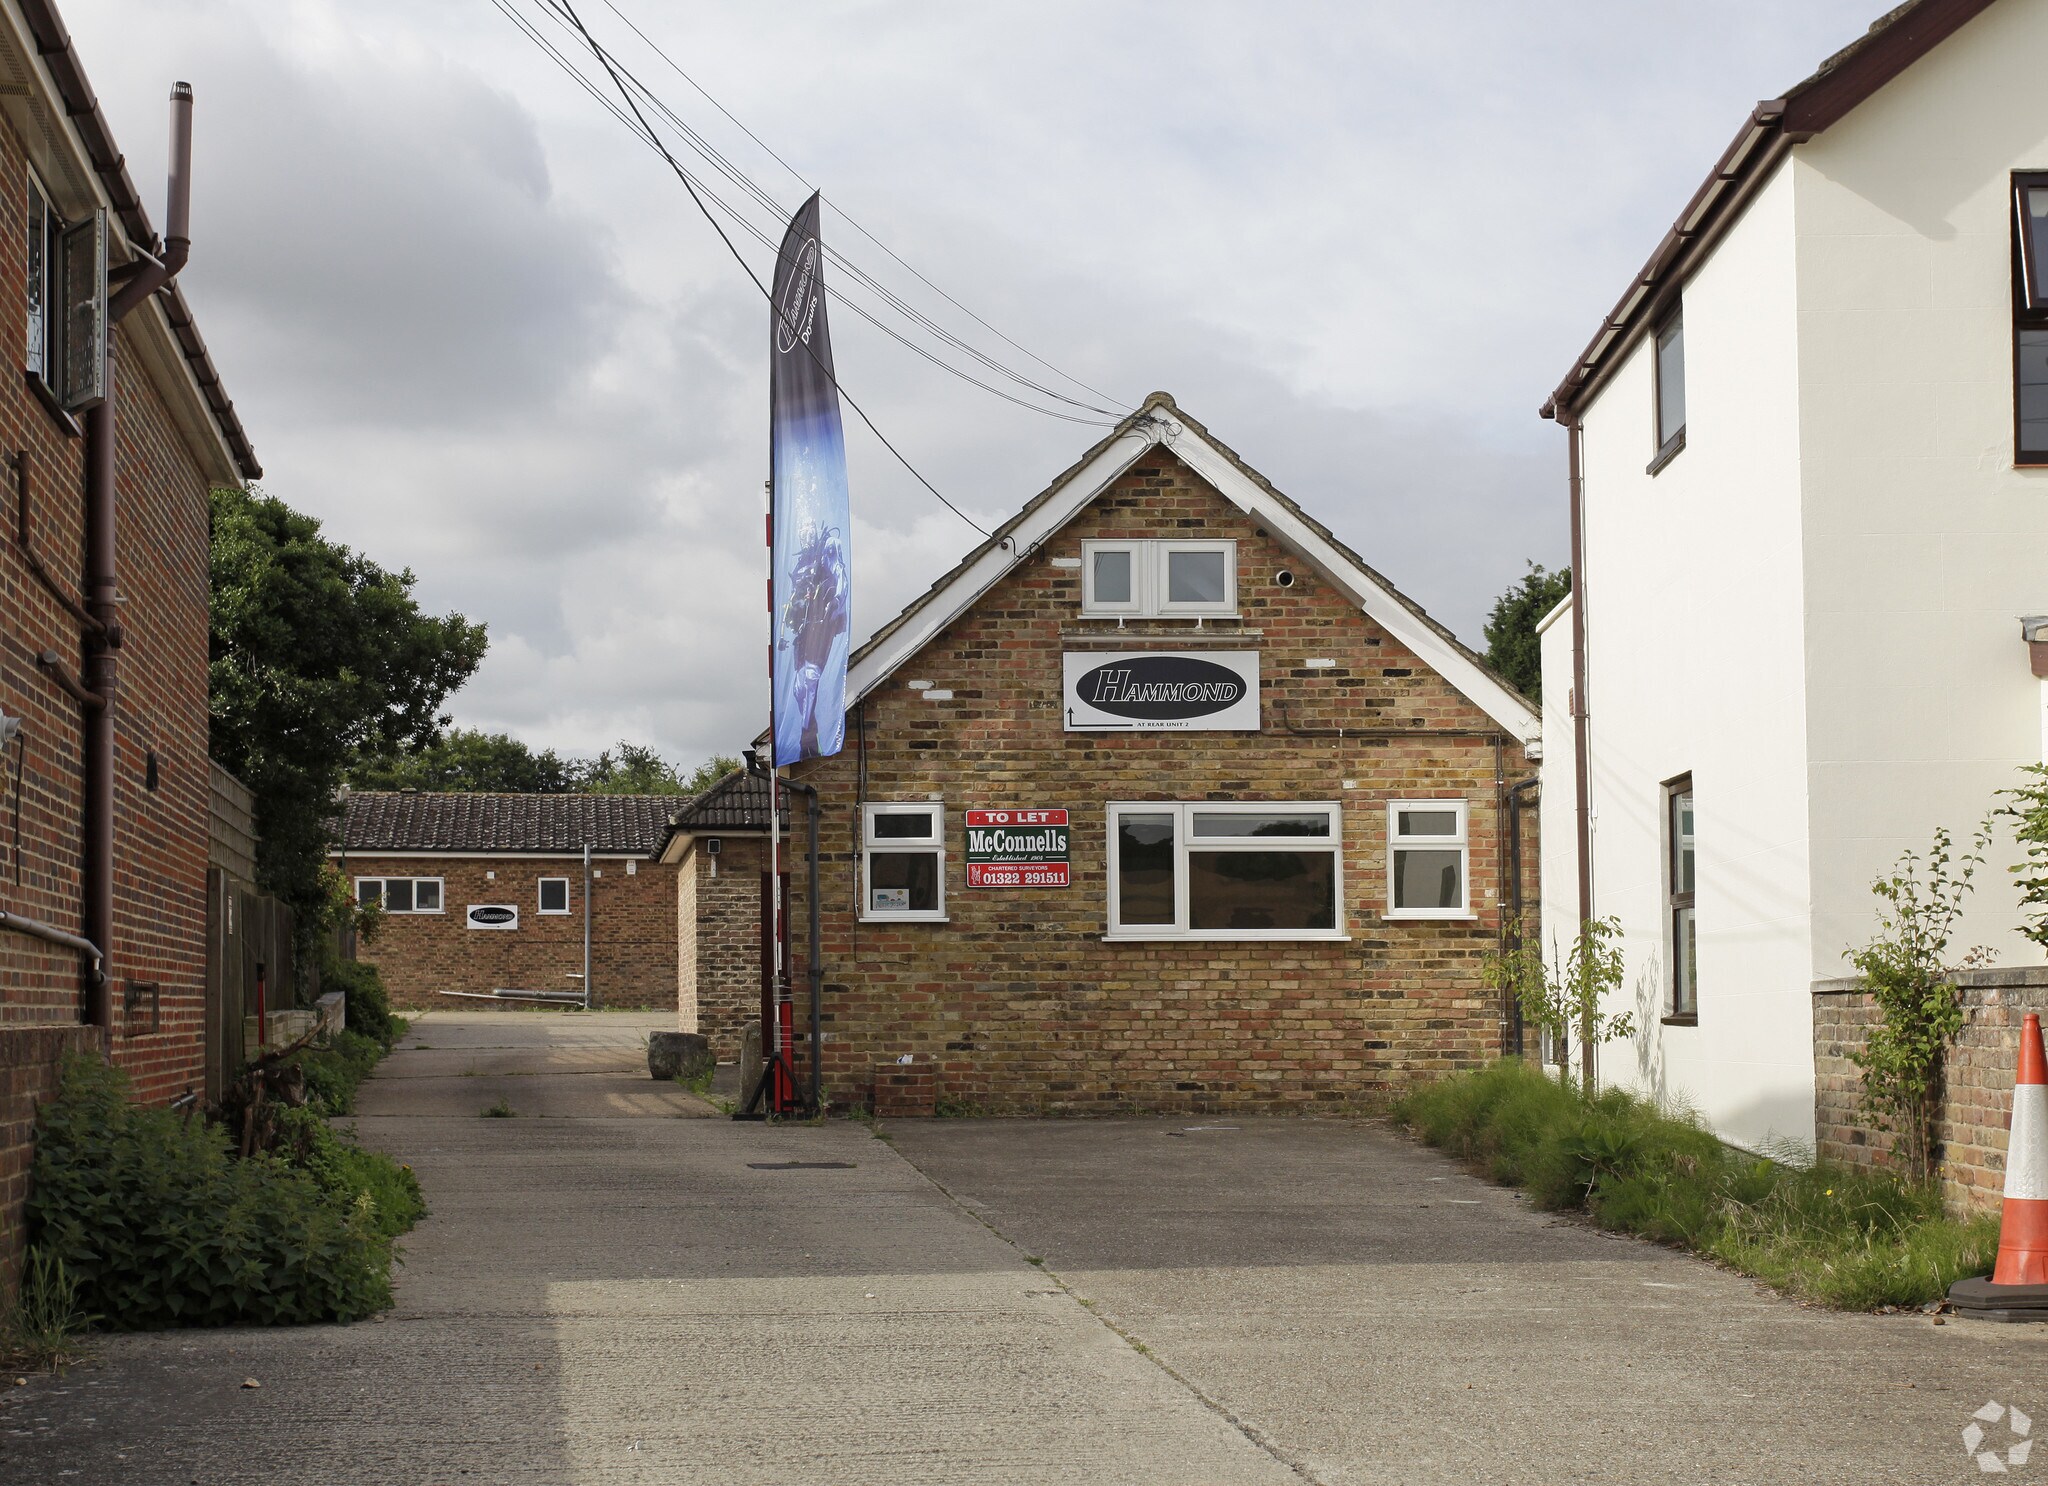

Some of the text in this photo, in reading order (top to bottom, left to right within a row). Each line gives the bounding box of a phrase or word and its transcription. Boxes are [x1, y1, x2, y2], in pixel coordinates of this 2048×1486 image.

[1092, 669, 1238, 702] HAMMOND
[985, 812, 1049, 823] TO LET
[968, 829, 1067, 853] McConnells
[983, 872, 1020, 884] 01322
[1024, 872, 1066, 884] 291511
